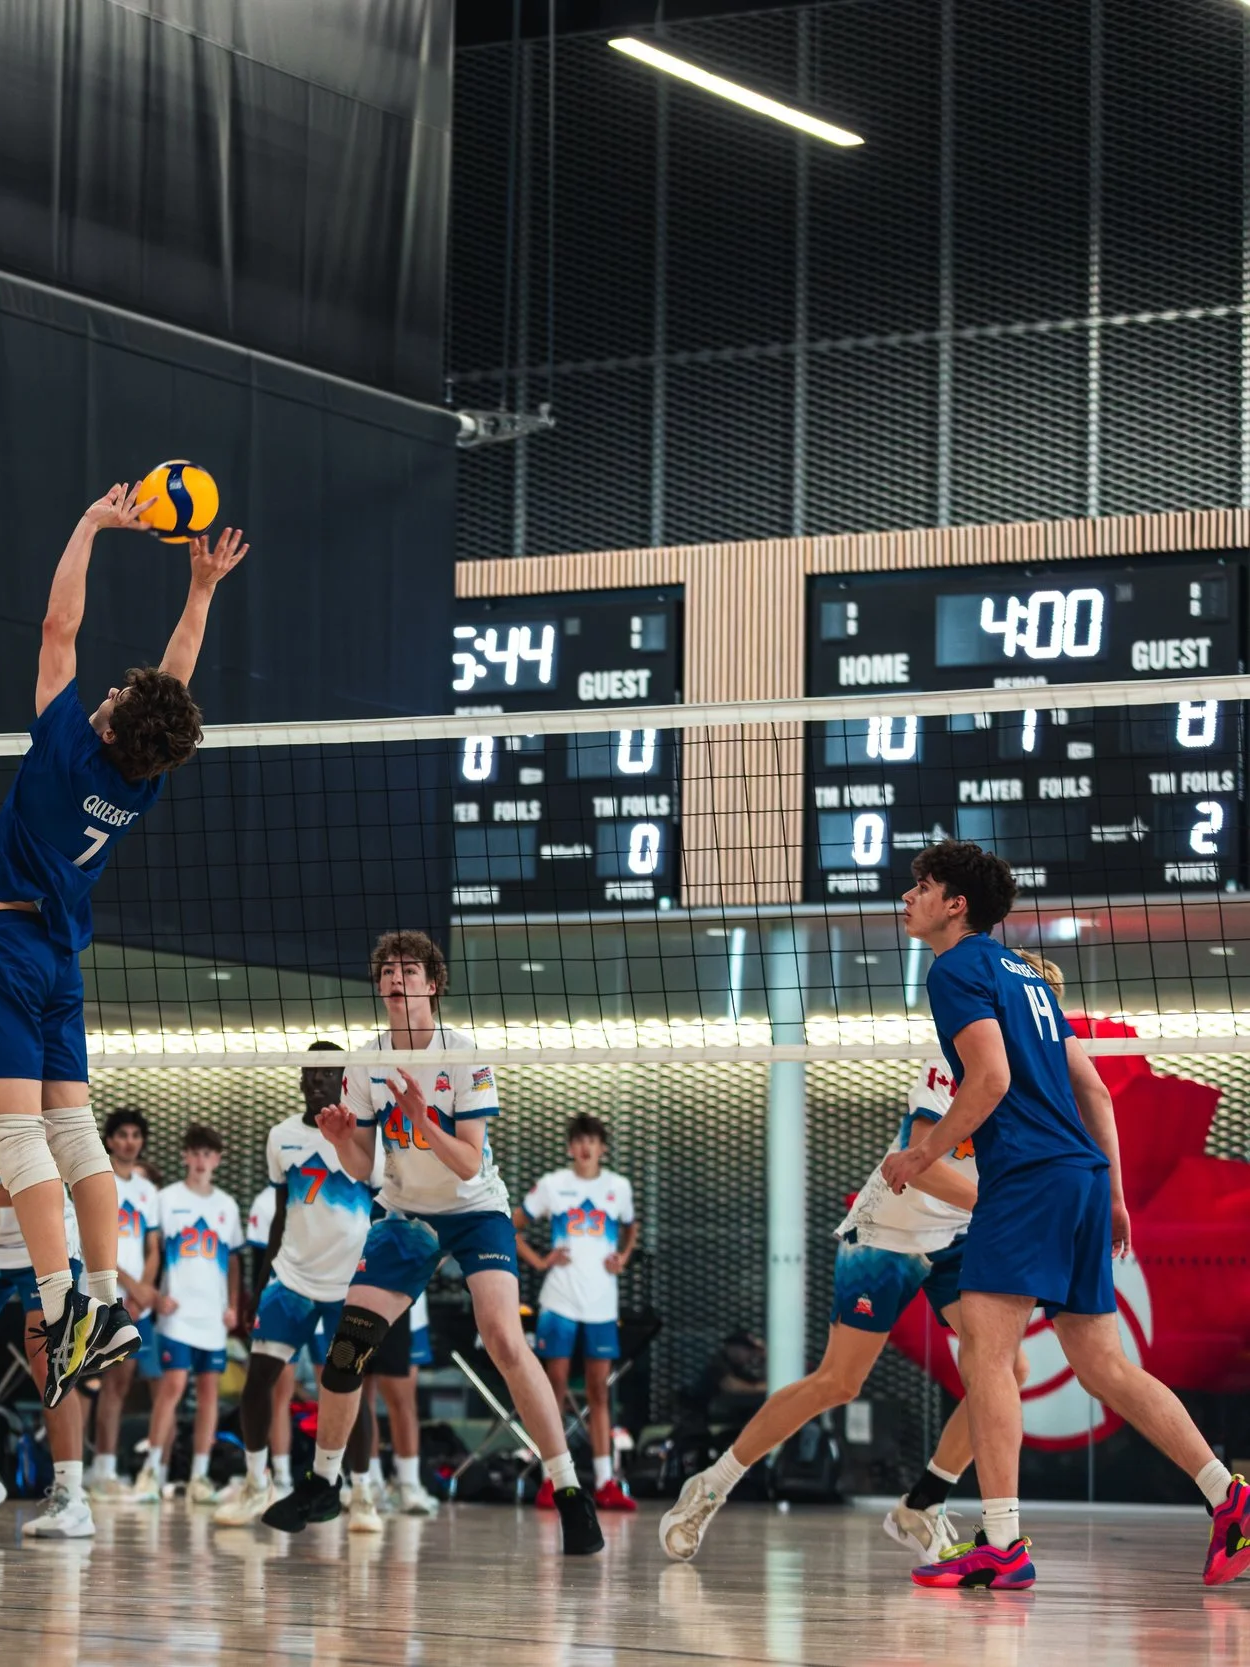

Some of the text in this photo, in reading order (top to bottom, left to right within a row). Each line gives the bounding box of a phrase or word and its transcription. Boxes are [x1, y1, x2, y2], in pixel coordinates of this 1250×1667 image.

[980, 588, 1105, 659] 4:00
[838, 653, 910, 686] HOME
[1131, 637, 1212, 672] GUEST
[578, 668, 652, 701] GUEST
[843, 783, 895, 806] FOULS
[959, 776, 1092, 802] PLAYER FOULS
[1181, 770, 1235, 793] FOULS
[493, 800, 542, 822] FOULS
[621, 795, 670, 817] FOULS
[852, 813, 885, 865] 0
[1189, 801, 1224, 854] 2
[71, 825, 110, 867] 7
[627, 823, 660, 874] 0
[1023, 983, 1060, 1043] 14
[300, 1167, 328, 1205] 7
[567, 1207, 607, 1236] 23
[180, 1226, 219, 1260] 20
